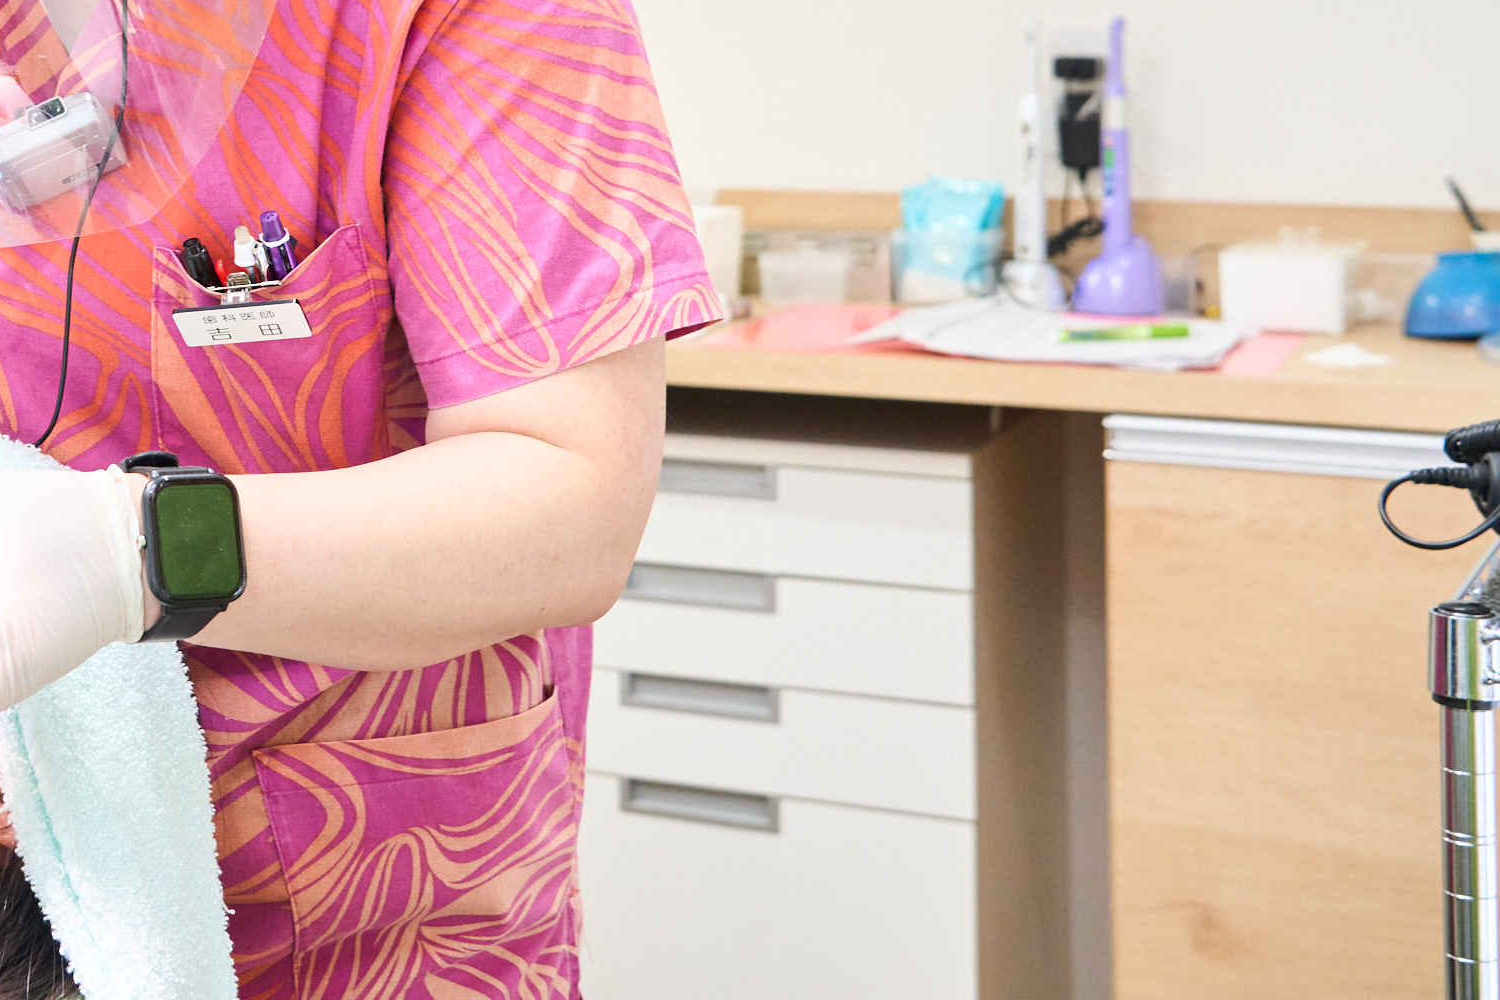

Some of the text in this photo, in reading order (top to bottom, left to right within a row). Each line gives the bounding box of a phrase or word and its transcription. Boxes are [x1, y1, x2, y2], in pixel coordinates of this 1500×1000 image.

[202, 310, 275, 324] 歯科医師
[206, 323, 283, 341] 吉田
